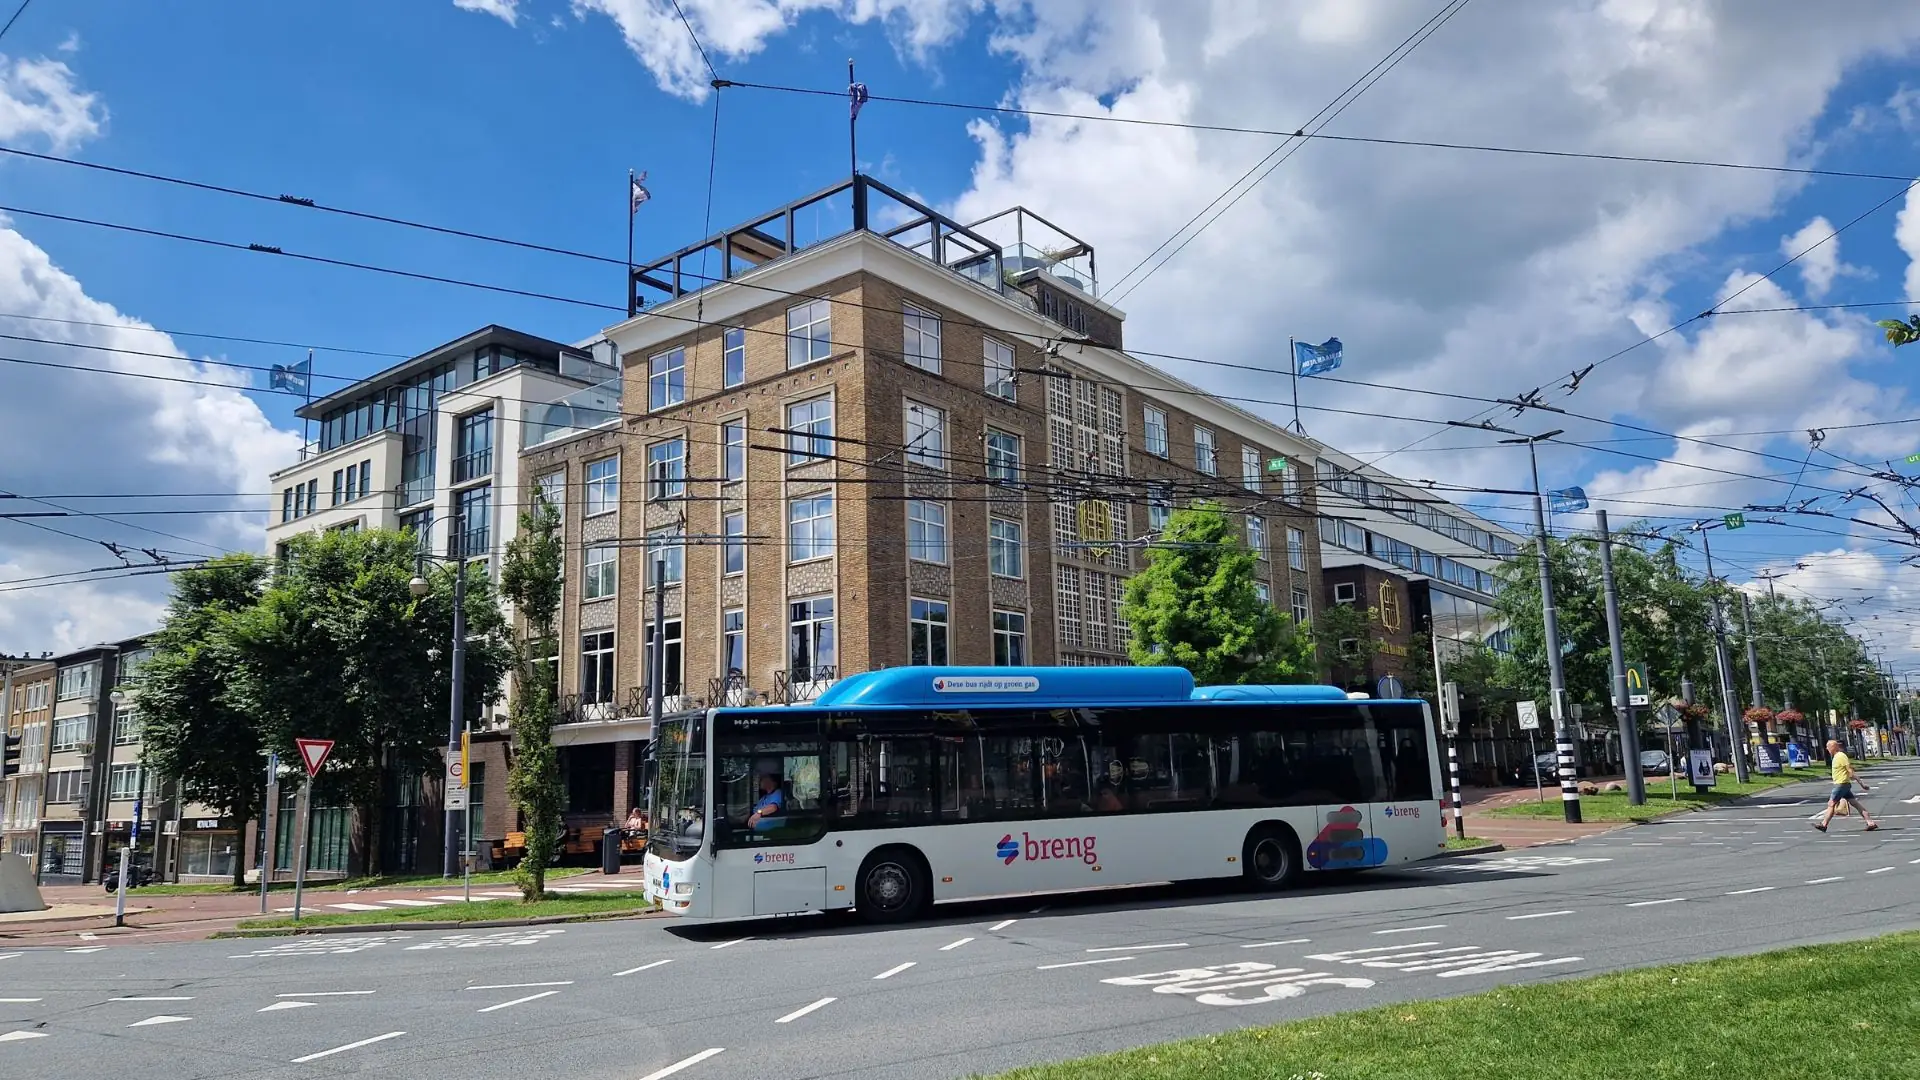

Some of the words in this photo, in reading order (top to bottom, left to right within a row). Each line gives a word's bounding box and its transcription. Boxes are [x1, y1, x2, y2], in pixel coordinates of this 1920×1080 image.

[1727, 516, 1740, 527] W
[965, 680, 977, 688] bus
[994, 681, 1003, 690] op
[1003, 681, 1023, 690] groen
[1024, 681, 1035, 690] gas
[1393, 804, 1420, 819] breng
[1022, 831, 1097, 865] breng
[765, 851, 795, 865] breng
[1098, 960, 1376, 1007] BUS
